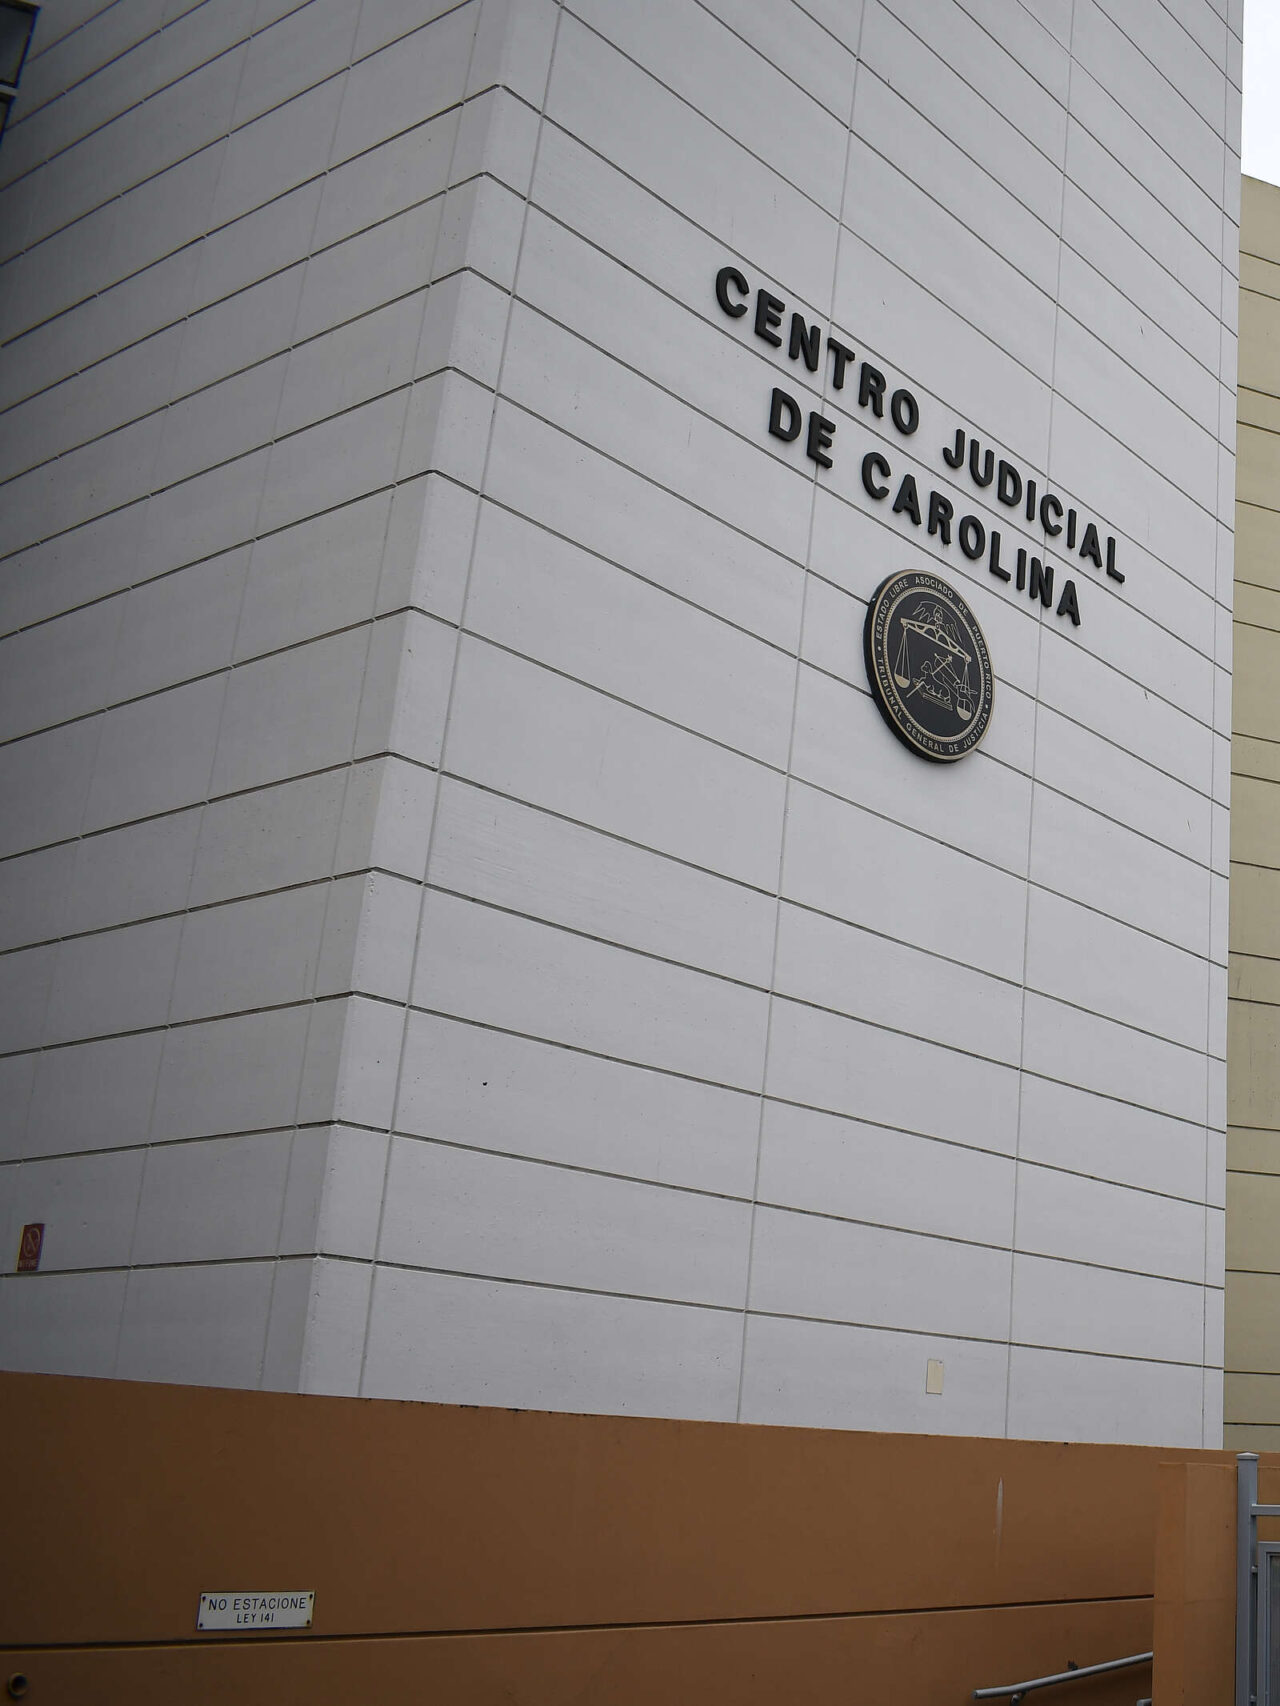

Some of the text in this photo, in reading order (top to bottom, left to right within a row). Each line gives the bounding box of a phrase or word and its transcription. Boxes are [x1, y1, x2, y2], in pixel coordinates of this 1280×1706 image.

[715, 266, 1126, 584] CENTRO JUDICIAL
[768, 387, 1081, 626] DE CAROLINA
[876, 600, 890, 640] ESTADO
[890, 578, 909, 599] LIBRE
[915, 576, 954, 599] ASOCIADO
[958, 603, 969, 616] DE
[972, 625, 990, 669] PUERTO
[877, 659, 988, 753] TRIBUNAL GENERAL DE JUSTICIA
[208, 1597, 307, 1611] NO ESTACIONE
[236, 1613, 274, 1623] LEY 141
